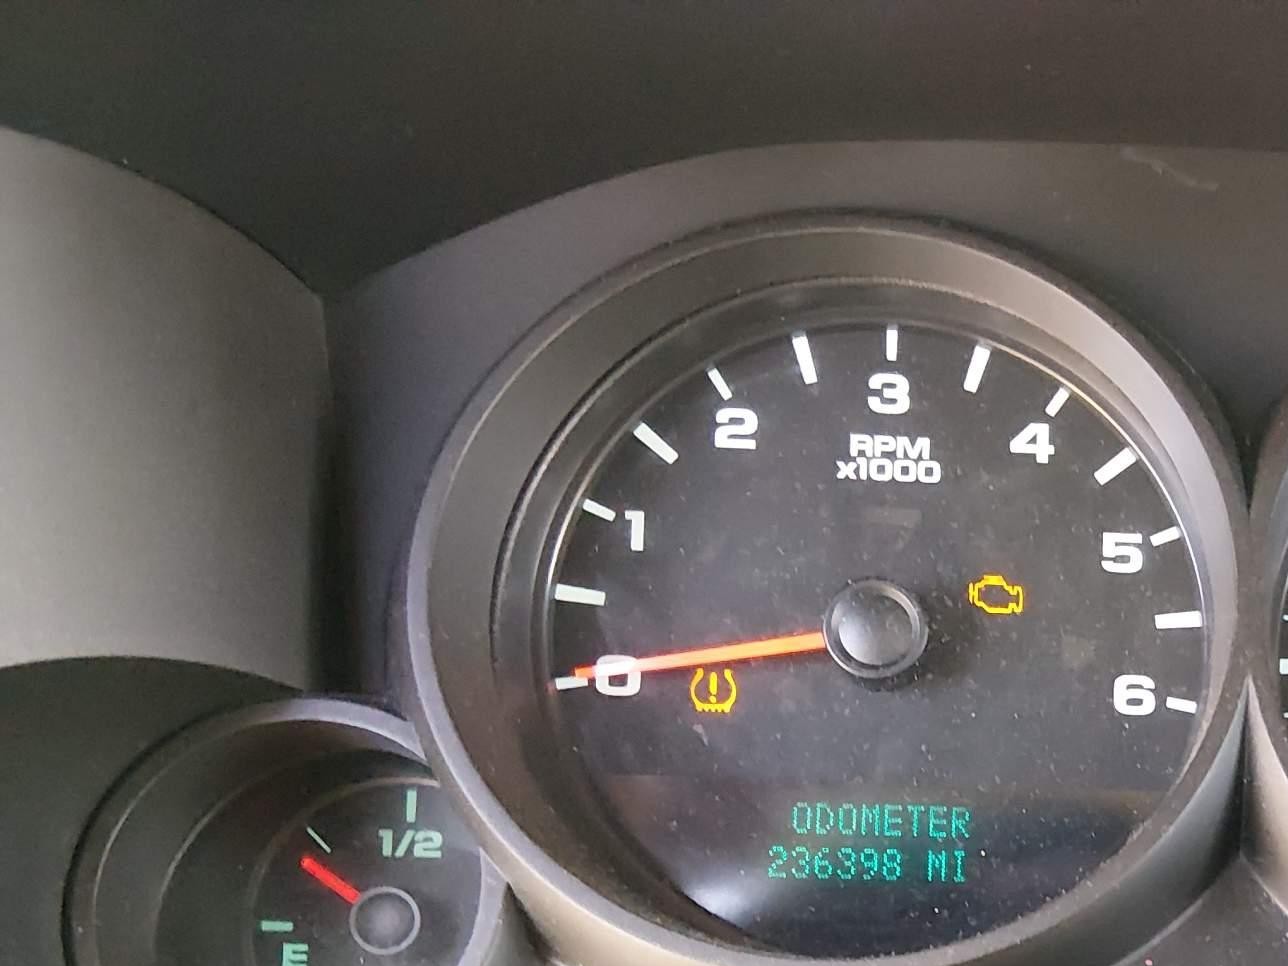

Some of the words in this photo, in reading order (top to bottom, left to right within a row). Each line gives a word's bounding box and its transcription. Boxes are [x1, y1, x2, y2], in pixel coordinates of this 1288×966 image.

[867, 372, 911, 415] 3
[714, 407, 759, 450] 2
[848, 433, 931, 460] RPM
[1009, 422, 1055, 464] 4
[836, 458, 942, 484] x1000
[624, 510, 645, 552] 1
[1100, 531, 1144, 574] 5
[595, 655, 641, 696] 0
[1113, 674, 1157, 716] 6
[792, 802, 971, 839] ODOMETER
[378, 829, 443, 859] 1/2
[768, 846, 902, 881] 236398
[927, 849, 966, 883] MI
